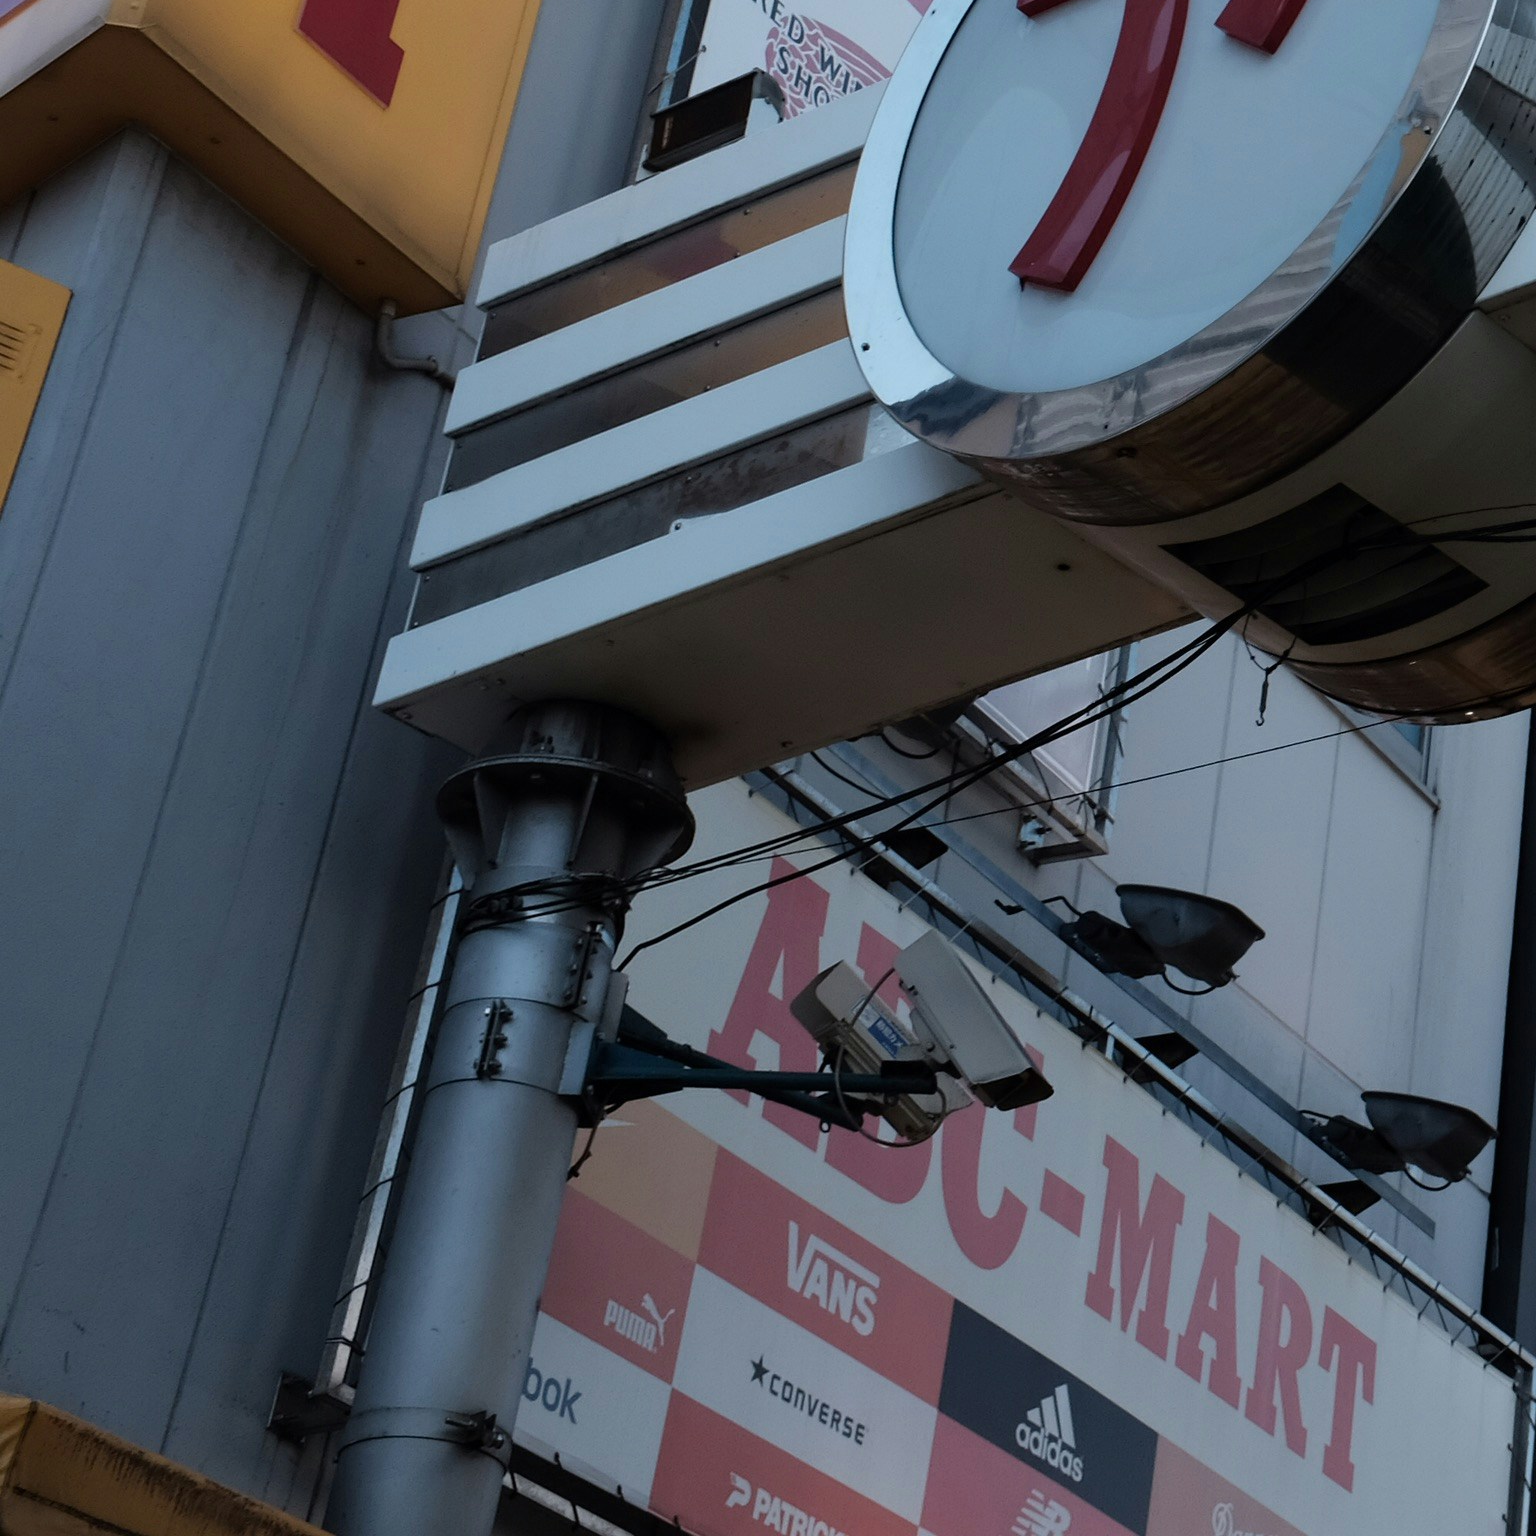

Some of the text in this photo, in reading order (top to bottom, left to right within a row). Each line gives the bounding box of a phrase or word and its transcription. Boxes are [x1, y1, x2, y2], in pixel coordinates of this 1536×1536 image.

[819, 38, 864, 95] WI
[787, 1220, 880, 1337] VANS
[603, 1298, 657, 1352] PUMA
[768, 1373, 866, 1447] CONVERSE
[1015, 1421, 1085, 1483] adidas
